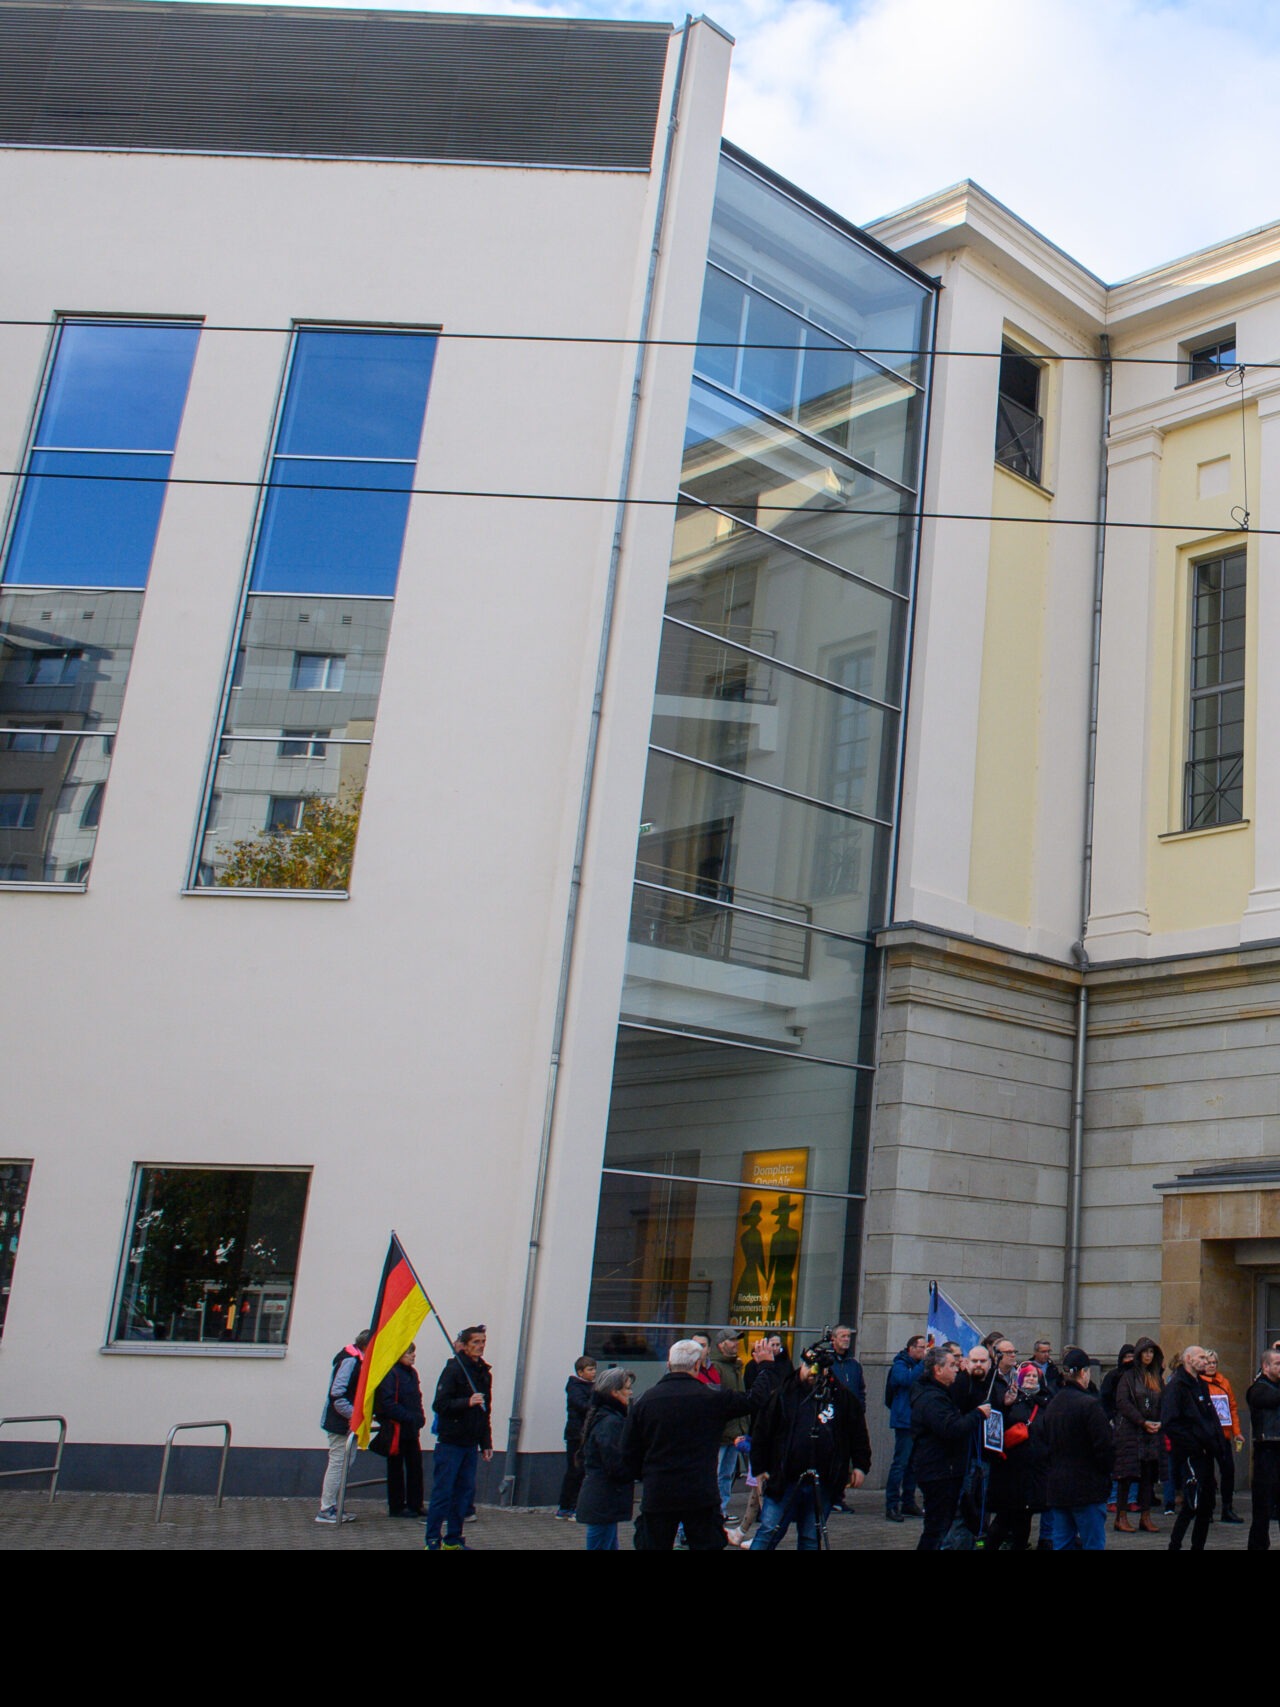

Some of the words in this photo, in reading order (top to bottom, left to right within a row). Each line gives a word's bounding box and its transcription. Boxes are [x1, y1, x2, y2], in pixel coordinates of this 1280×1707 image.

[753, 1164, 794, 1177] Domplatz
[754, 1175, 791, 1186] OpenAir
[738, 1293, 762, 1303] Rodgers
[730, 1316, 794, 1328] Oklahoma!
